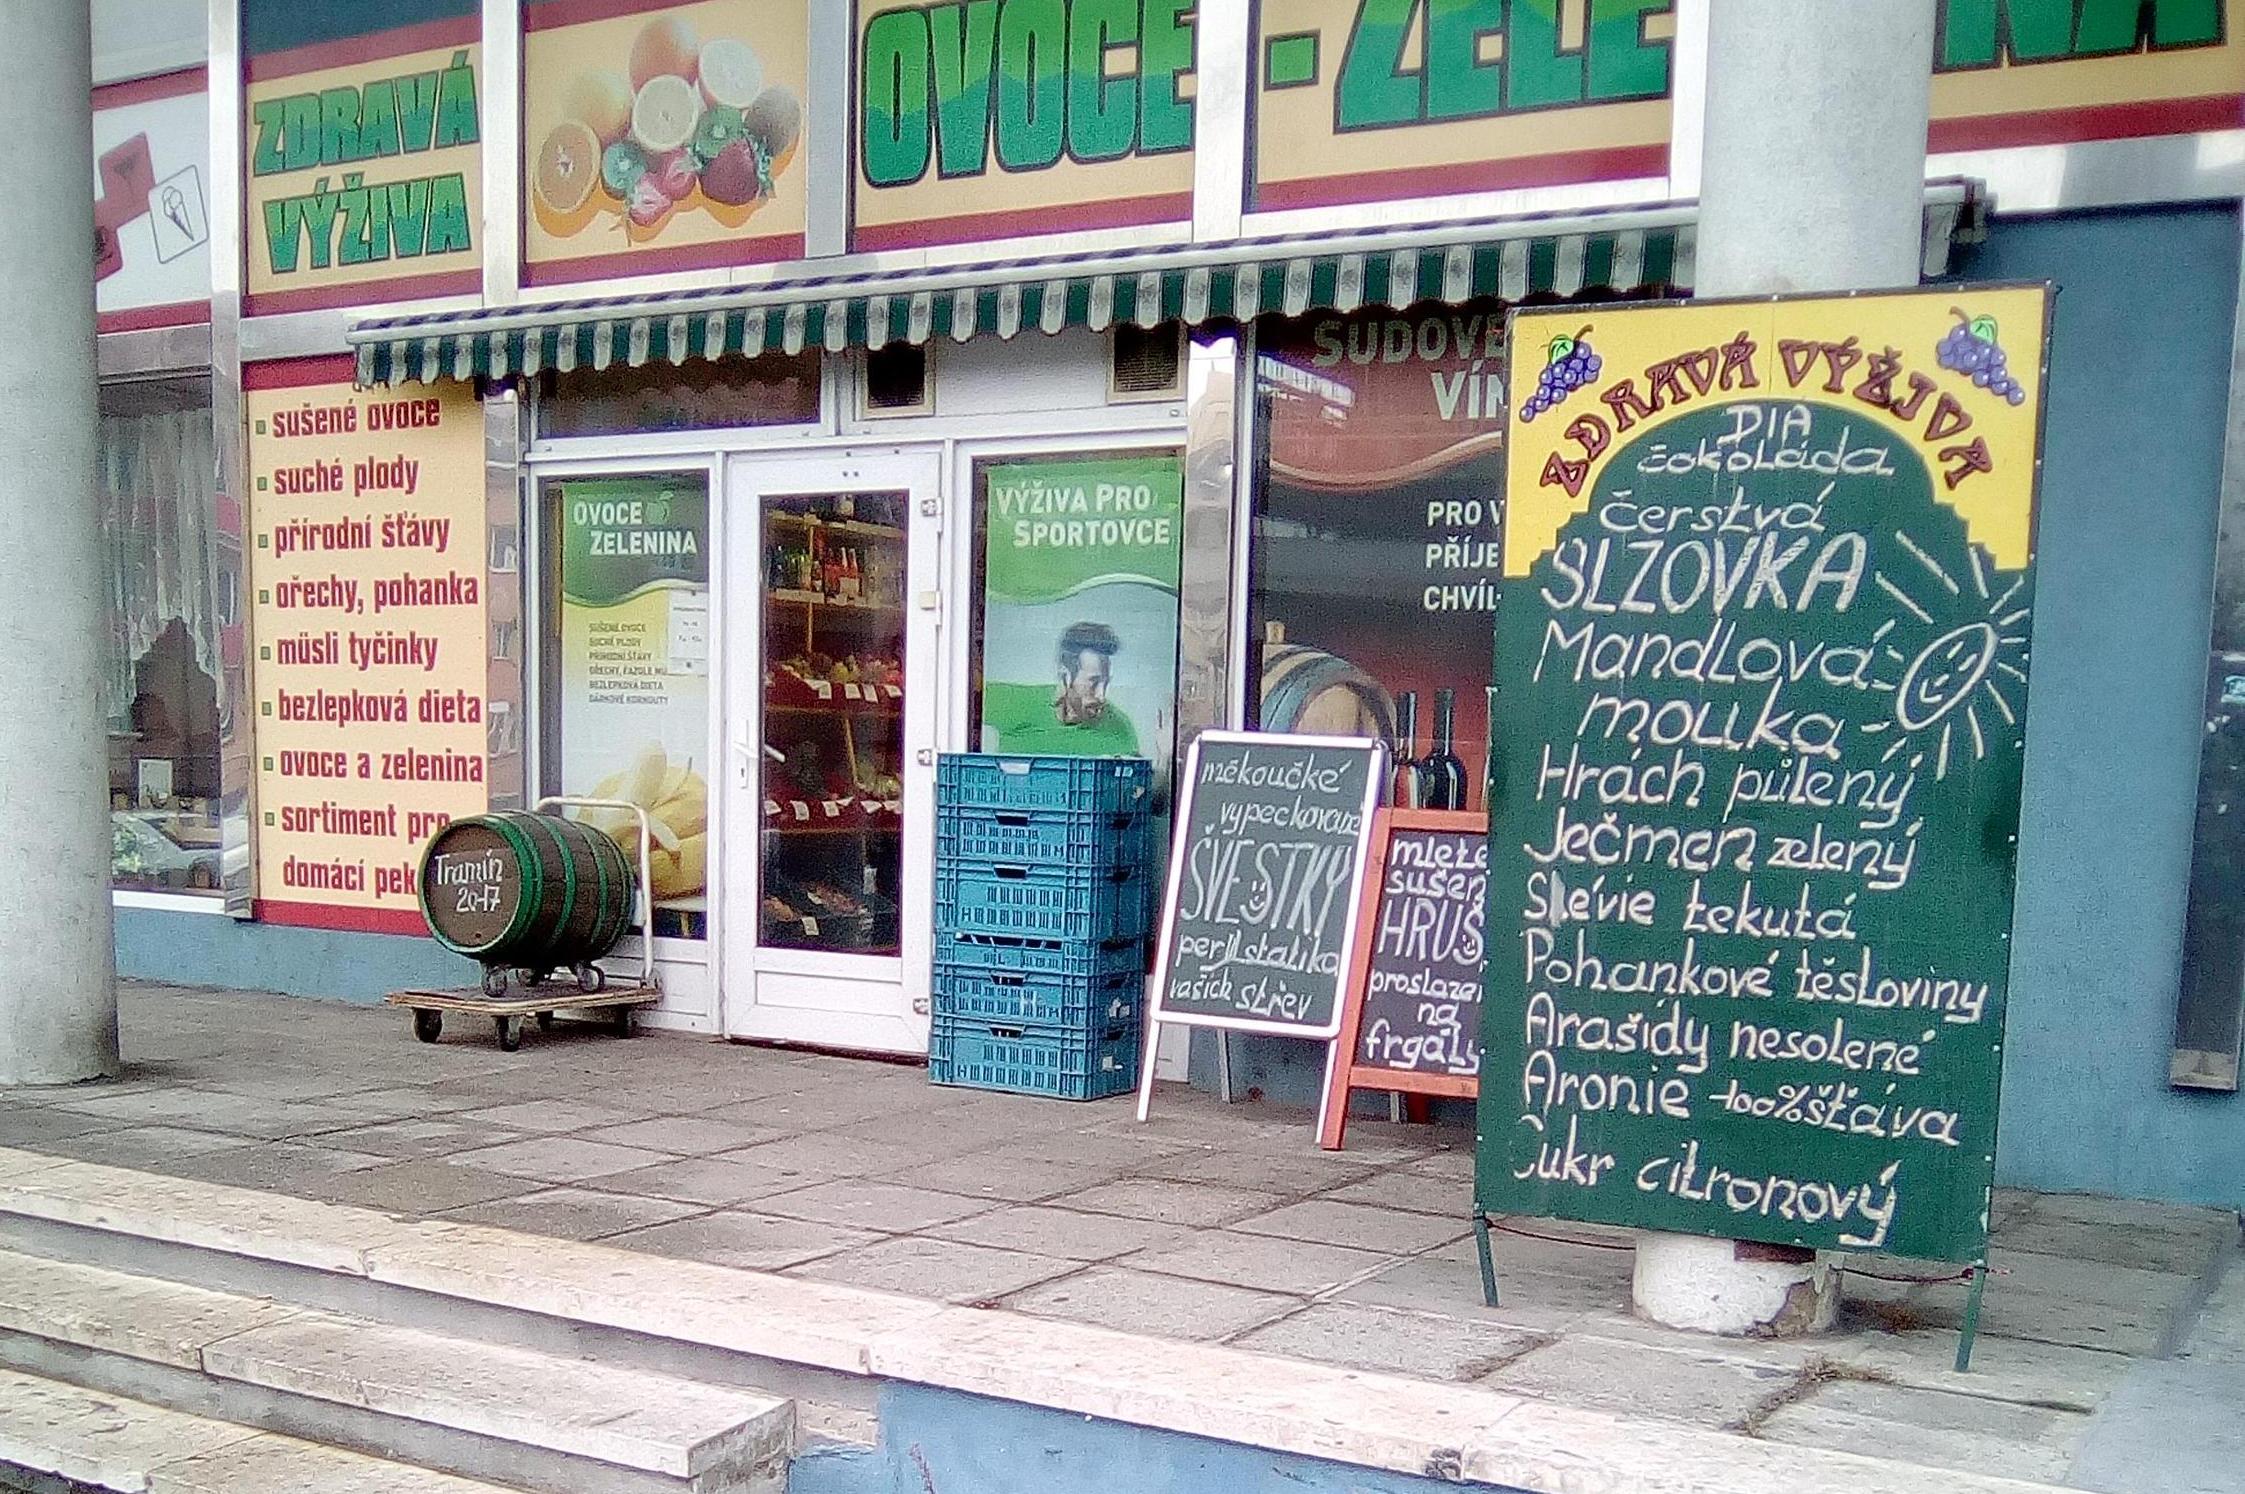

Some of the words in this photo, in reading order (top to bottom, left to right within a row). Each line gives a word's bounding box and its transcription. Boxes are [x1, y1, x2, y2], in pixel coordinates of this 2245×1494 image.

[253, 50, 480, 176] ZDRAVÁ
[861, 0, 1196, 188] OVOCE
[262, 172, 472, 274] VÝŽIVA
[273, 398, 358, 437] sušené
[368, 399, 440, 430] ovoce
[1539, 331, 1760, 498] ZDRAVÁ
[1716, 404, 1812, 447] DIA
[274, 458, 343, 494] suché
[354, 454, 419, 496] plody
[573, 502, 642, 525] OVOCE
[996, 480, 1088, 515] VÝŽIVA
[1096, 483, 1151, 511] PRO
[1427, 501, 1482, 527] PRO
[275, 515, 371, 558] přírodní
[382, 511, 450, 552] šťávy
[590, 531, 697, 555] ZELENINA
[1013, 519, 1171, 547] SPORTOVCE
[1426, 535, 1498, 568] PŘÍJE
[276, 574, 364, 614] ořechy,
[374, 571, 478, 613] pohanka
[1541, 531, 1867, 615] SLZOVKA
[277, 632, 339, 665] müsli
[348, 631, 438, 671] tyčinky
[278, 688, 408, 727] bezlepková
[418, 689, 481, 723] dieta
[1577, 675, 1845, 760] mouka
[280, 750, 347, 778] ovoce
[357, 753, 371, 779] a
[381, 747, 483, 782] zelenina
[1200, 750, 1354, 793] měkoučké
[1536, 743, 1705, 806] Hrách
[1723, 752, 1923, 832] půlený
[281, 802, 397, 837] sortiment
[1522, 806, 1757, 872] Ječmen
[1767, 816, 1924, 890] zelený
[283, 855, 365, 891] domácí
[375, 862, 417, 899] pek
[1181, 824, 1352, 937] ŠVESTKY
[1683, 879, 1856, 940] tekutá
[1525, 927, 1779, 997] Pohankové
[1417, 1002, 1461, 1029] na
[1526, 992, 1709, 1073] Arašídy
[1730, 1017, 1936, 1075] nesolené
[1524, 1049, 1690, 1119] Aronie
[1637, 1140, 1901, 1248] citronový
